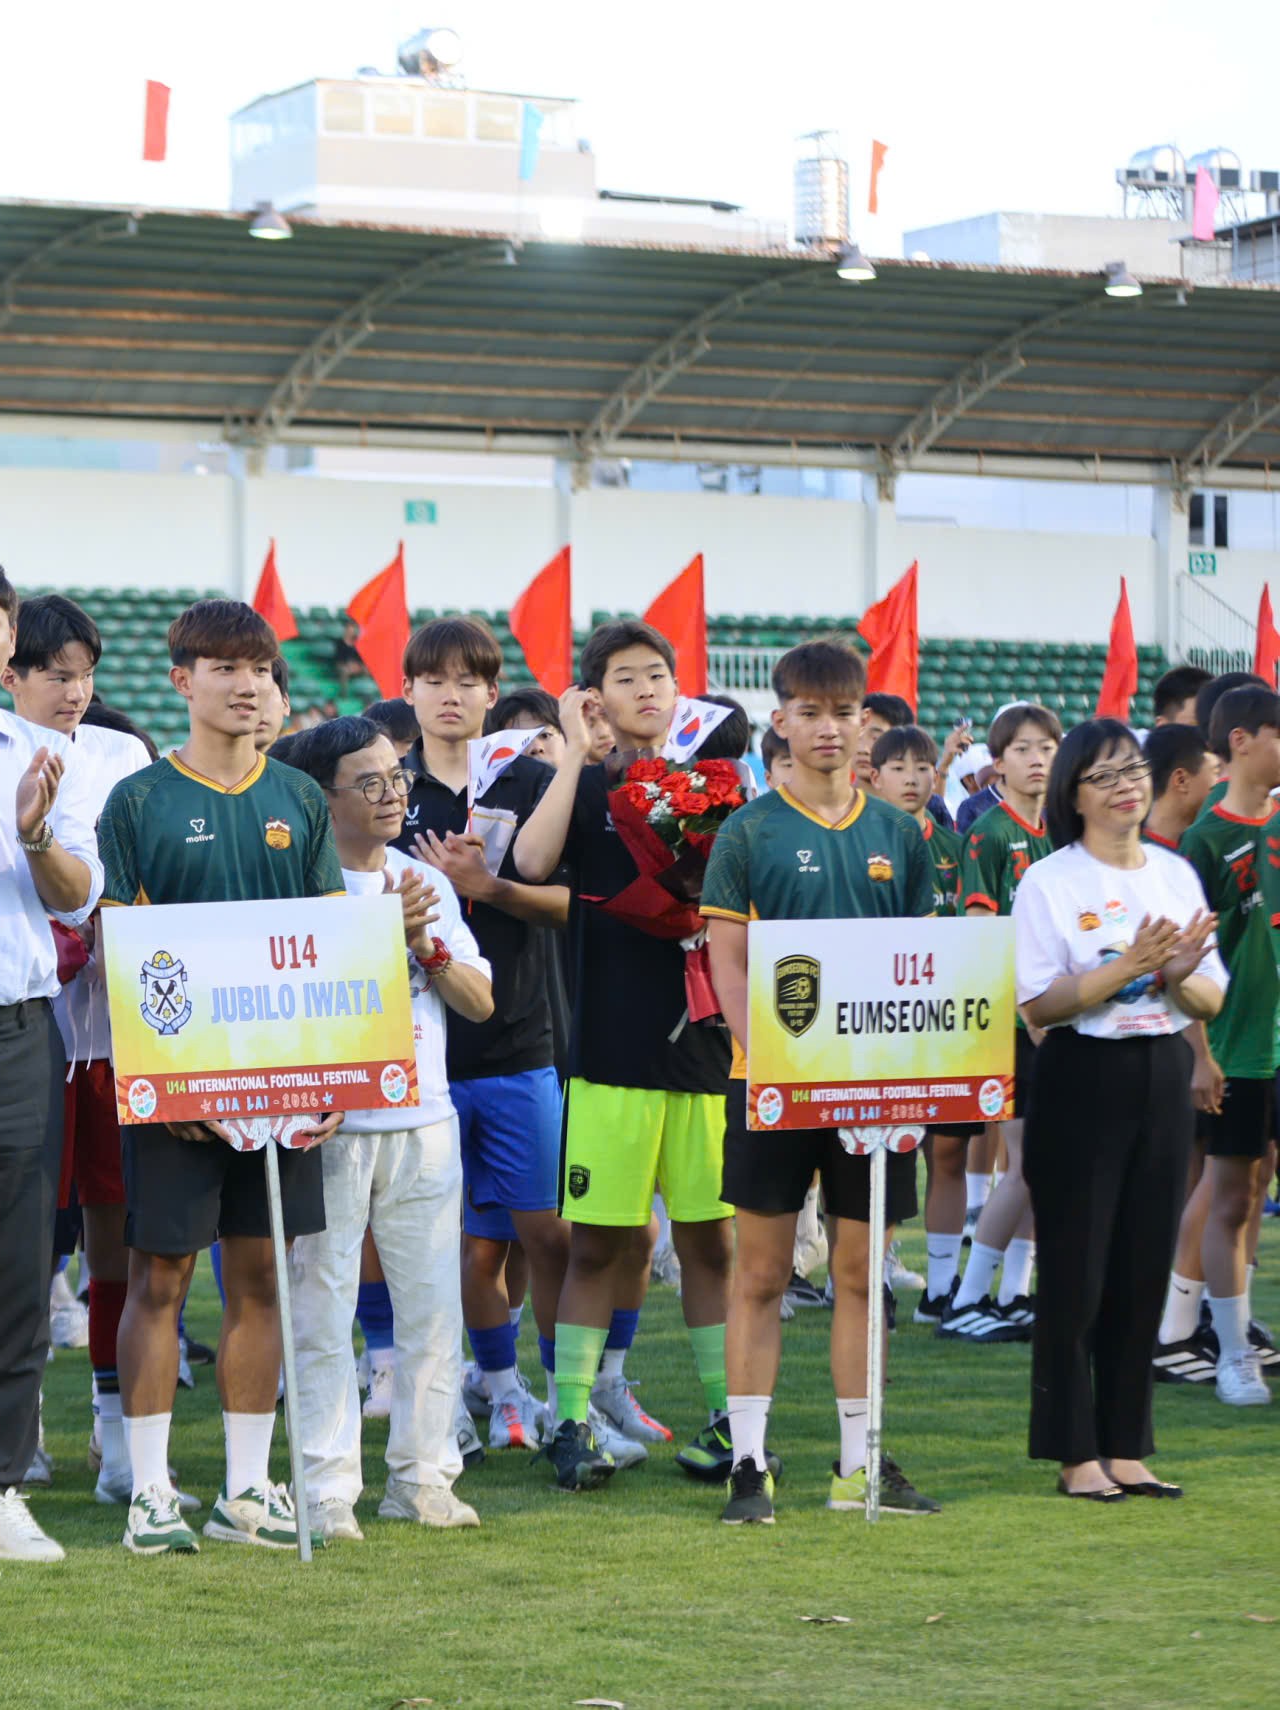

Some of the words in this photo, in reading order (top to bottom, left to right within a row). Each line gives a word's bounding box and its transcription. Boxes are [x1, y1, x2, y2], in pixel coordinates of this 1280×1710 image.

[185, 833, 215, 844] motive
[269, 934, 318, 970] U14
[894, 952, 935, 986] U14
[211, 984, 296, 1024] JUBILO
[304, 979, 383, 1018] IWATA
[836, 1000, 955, 1035] EUMSEONG
[964, 998, 991, 1031] FC
[166, 1080, 187, 1094] U14
[188, 1075, 268, 1093] INTERNATIONAL
[270, 1072, 321, 1089] FOOTBALL
[323, 1069, 370, 1085] FESTIVAL
[792, 1089, 810, 1103] U14
[811, 1086, 881, 1102] INTERNATIONAL
[882, 1085, 928, 1099] FOOTBALL
[929, 1083, 971, 1097] FESTIVAL
[216, 1098, 241, 1112] GIA
[246, 1096, 269, 1111] LAI
[282, 1094, 319, 1109] 2026
[833, 1107, 855, 1121] GIA
[859, 1105, 881, 1120] LAI
